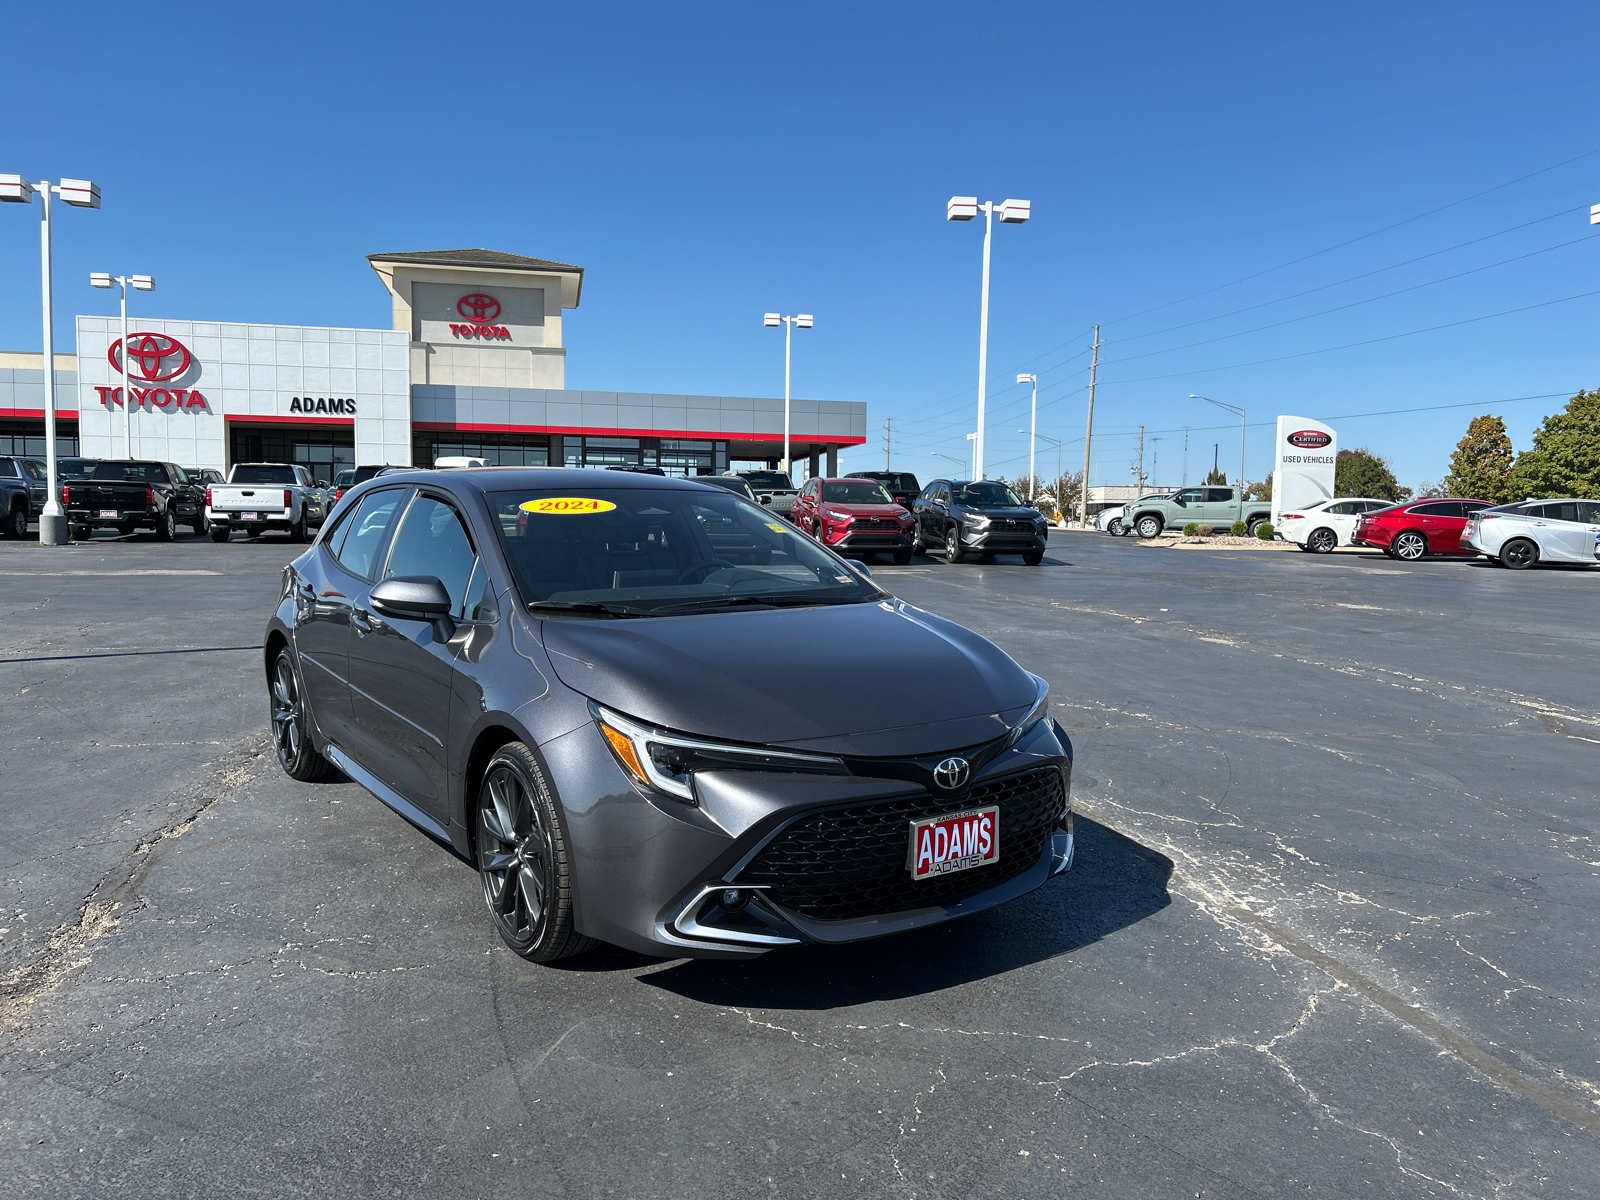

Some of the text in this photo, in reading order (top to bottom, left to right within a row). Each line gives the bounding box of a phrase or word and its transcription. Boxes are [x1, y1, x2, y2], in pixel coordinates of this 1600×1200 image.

[449, 324, 509, 337] TOYOTA
[94, 386, 206, 408] TOYOTA
[290, 397, 356, 414] ADAMS
[1303, 456, 1333, 464] VEHICLES
[539, 501, 600, 511] 2024
[936, 810, 978, 823] KANSAS CITY
[917, 818, 991, 869] ADAMS
[932, 855, 980, 876] ADAMS
